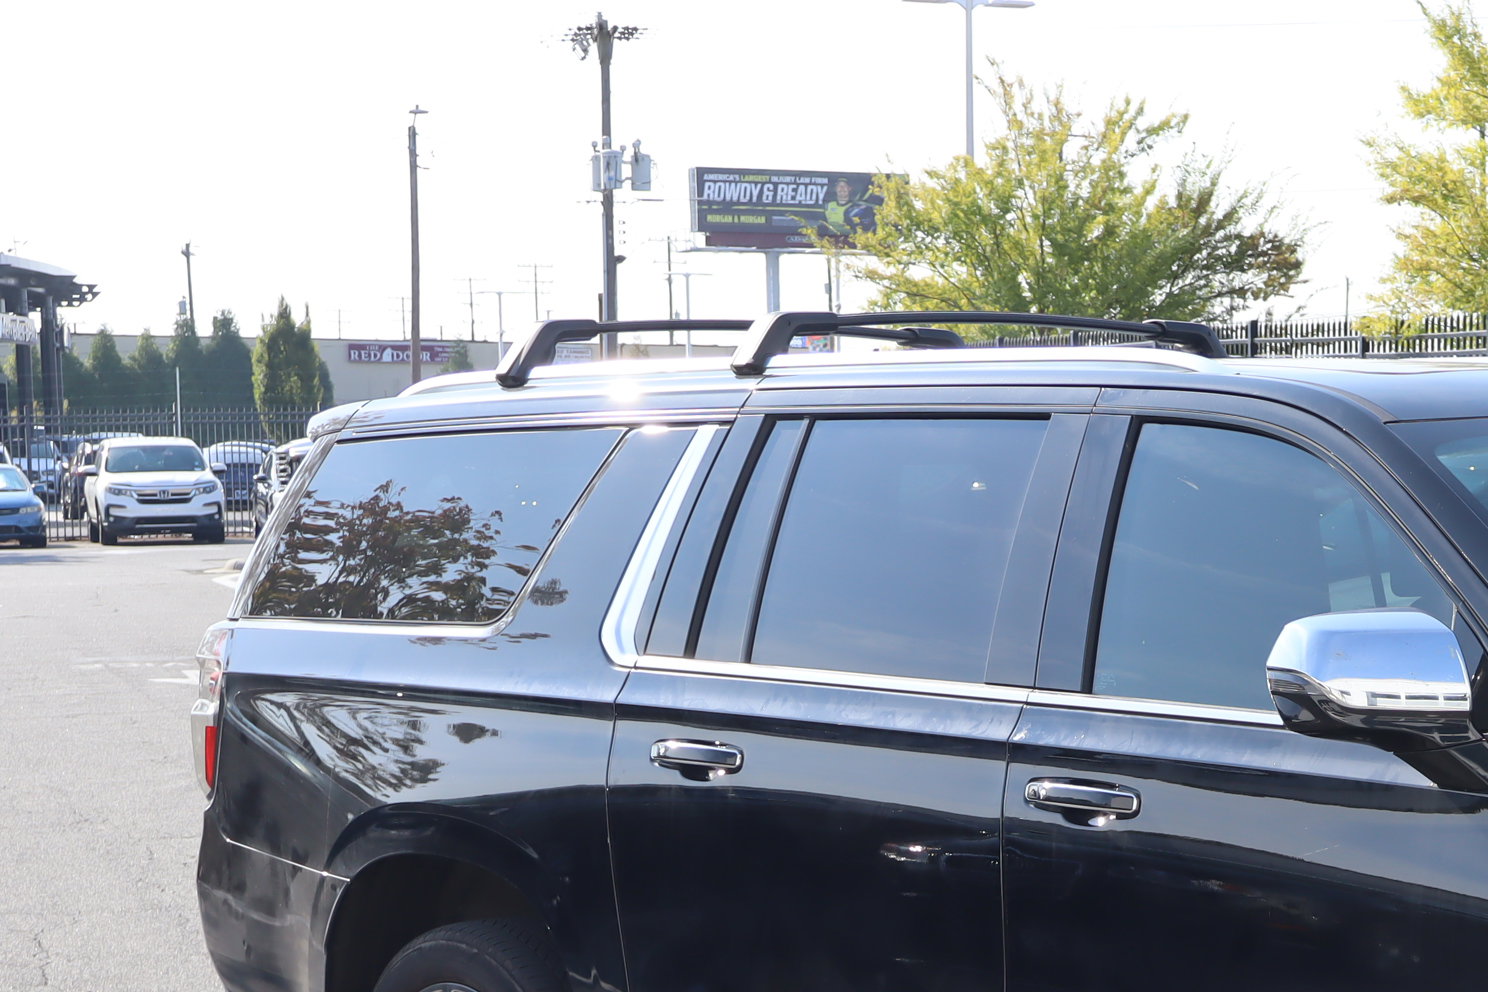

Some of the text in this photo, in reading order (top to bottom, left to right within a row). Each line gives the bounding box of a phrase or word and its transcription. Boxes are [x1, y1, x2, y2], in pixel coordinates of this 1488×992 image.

[703, 173, 739, 181] AMERICA'S
[741, 174, 770, 182] LARGEST
[796, 176, 811, 184] LAW
[703, 182, 828, 205] ROWDY & READY
[350, 350, 380, 361] RED
[391, 351, 431, 362] DOR
